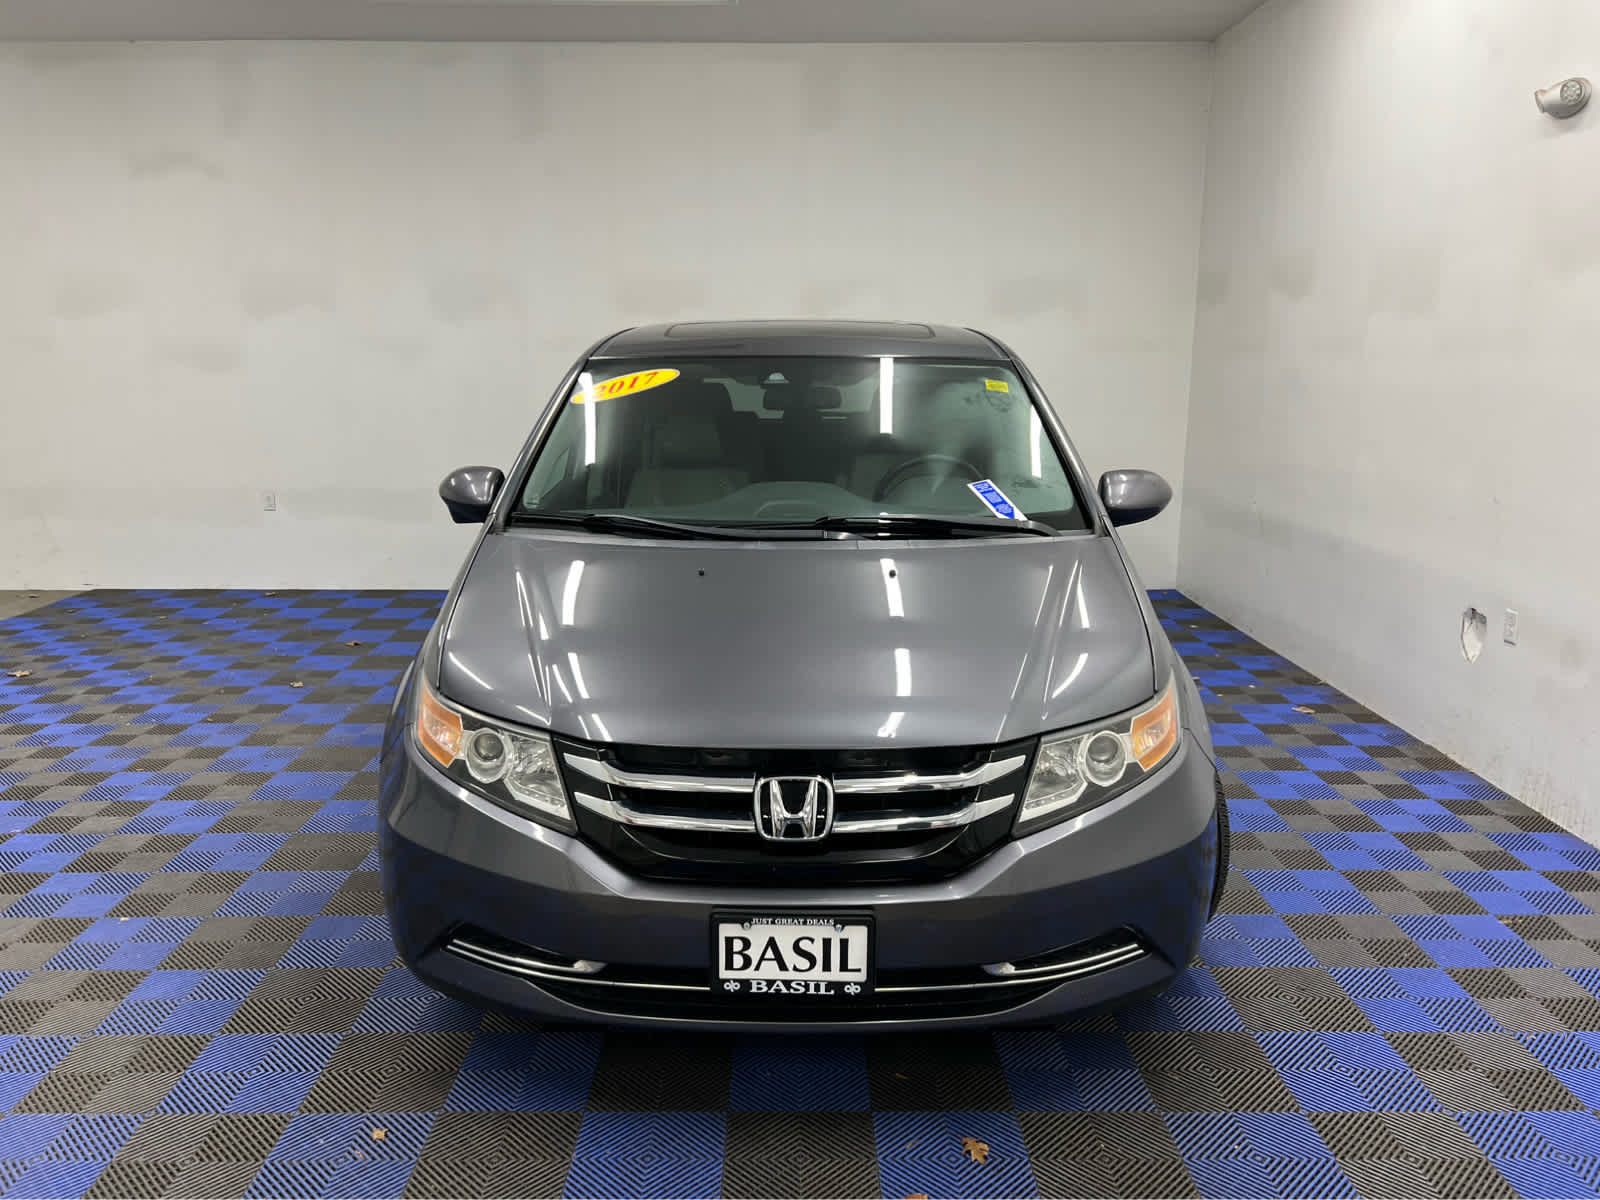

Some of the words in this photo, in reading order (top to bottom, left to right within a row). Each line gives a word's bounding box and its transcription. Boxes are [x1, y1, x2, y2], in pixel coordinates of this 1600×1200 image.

[751, 917, 773, 926] JUST
[775, 918, 805, 926] GREAT
[807, 918, 835, 927] DEALS
[724, 936, 862, 972] BASIL
[750, 979, 835, 995] BASIL
